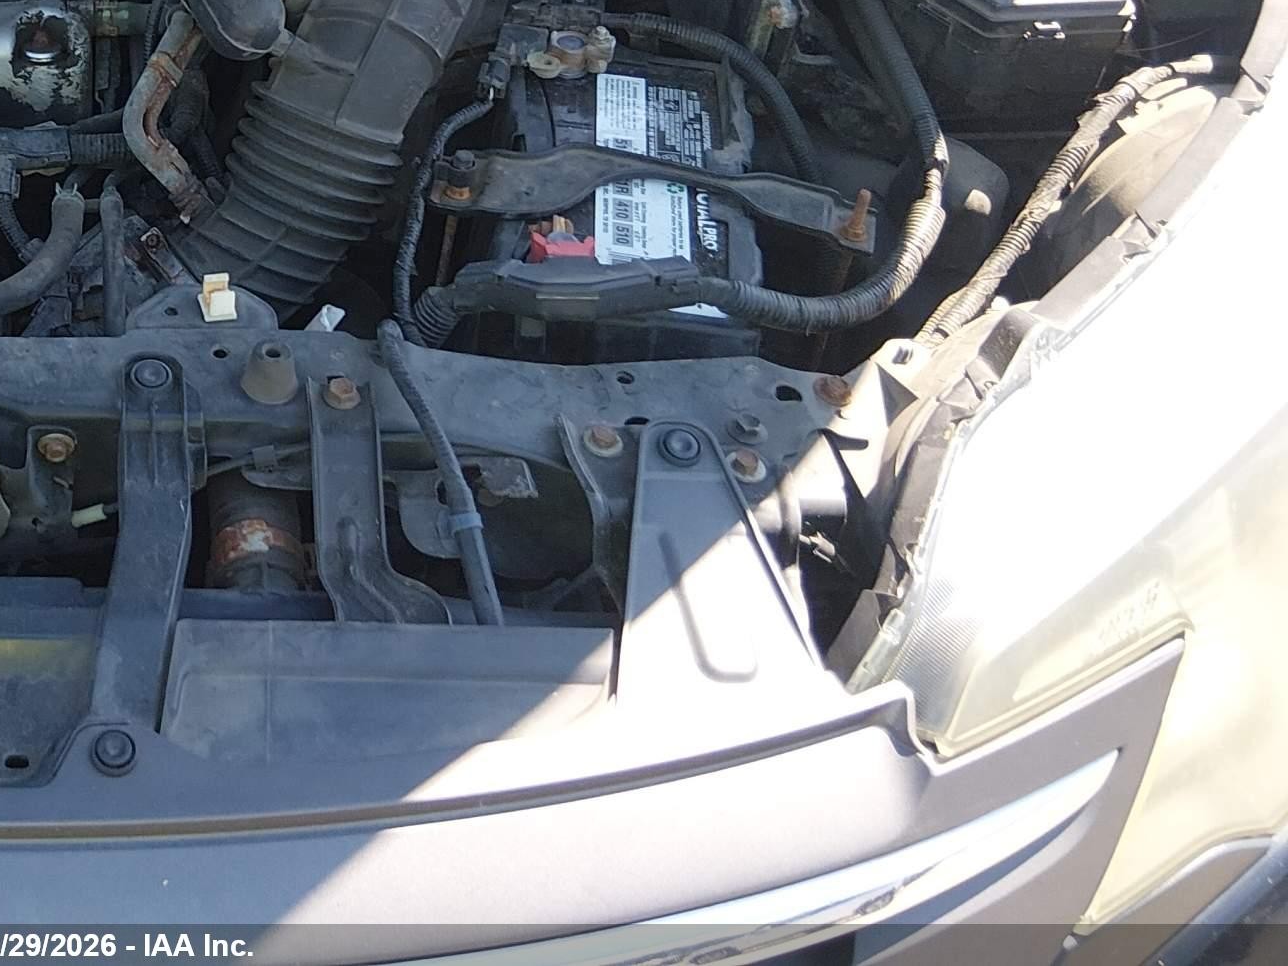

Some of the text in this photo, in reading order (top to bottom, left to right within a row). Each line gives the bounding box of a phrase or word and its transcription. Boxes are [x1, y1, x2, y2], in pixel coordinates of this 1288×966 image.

[615, 180, 630, 194] 1R
[615, 200, 630, 220] 410
[615, 225, 630, 244] 510
